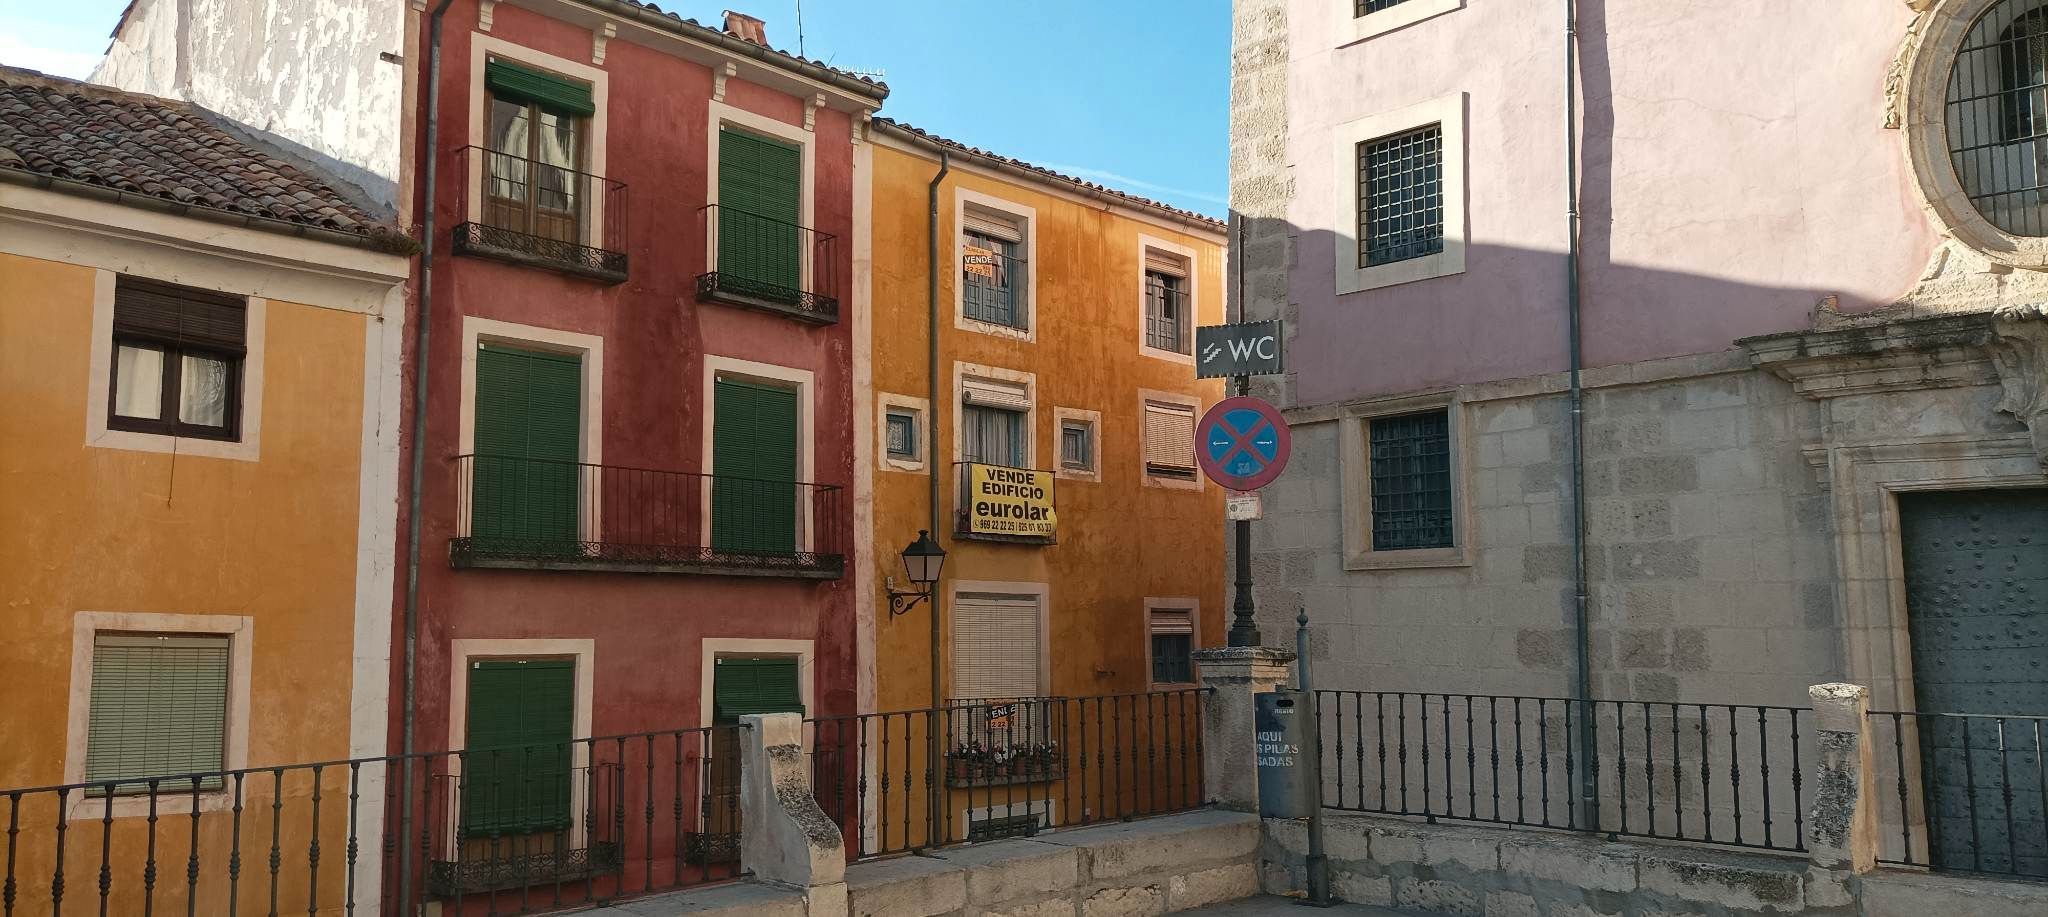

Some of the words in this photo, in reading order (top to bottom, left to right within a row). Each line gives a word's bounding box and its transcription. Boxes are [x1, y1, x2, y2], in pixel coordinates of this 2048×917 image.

[965, 255, 992, 264] VENDE
[1228, 336, 1274, 362] WC
[986, 469, 1035, 485] VENDE
[982, 482, 1044, 499] EDIFICIO
[976, 501, 1049, 520] eurolar
[980, 520, 990, 530] 969
[992, 520, 998, 530] 22
[1000, 521, 1006, 531] 22
[1008, 522, 1015, 531] 25
[1258, 731, 1282, 742] AQUI
[1264, 744, 1299, 754] PILAS
[1258, 757, 1293, 767] SADAS
